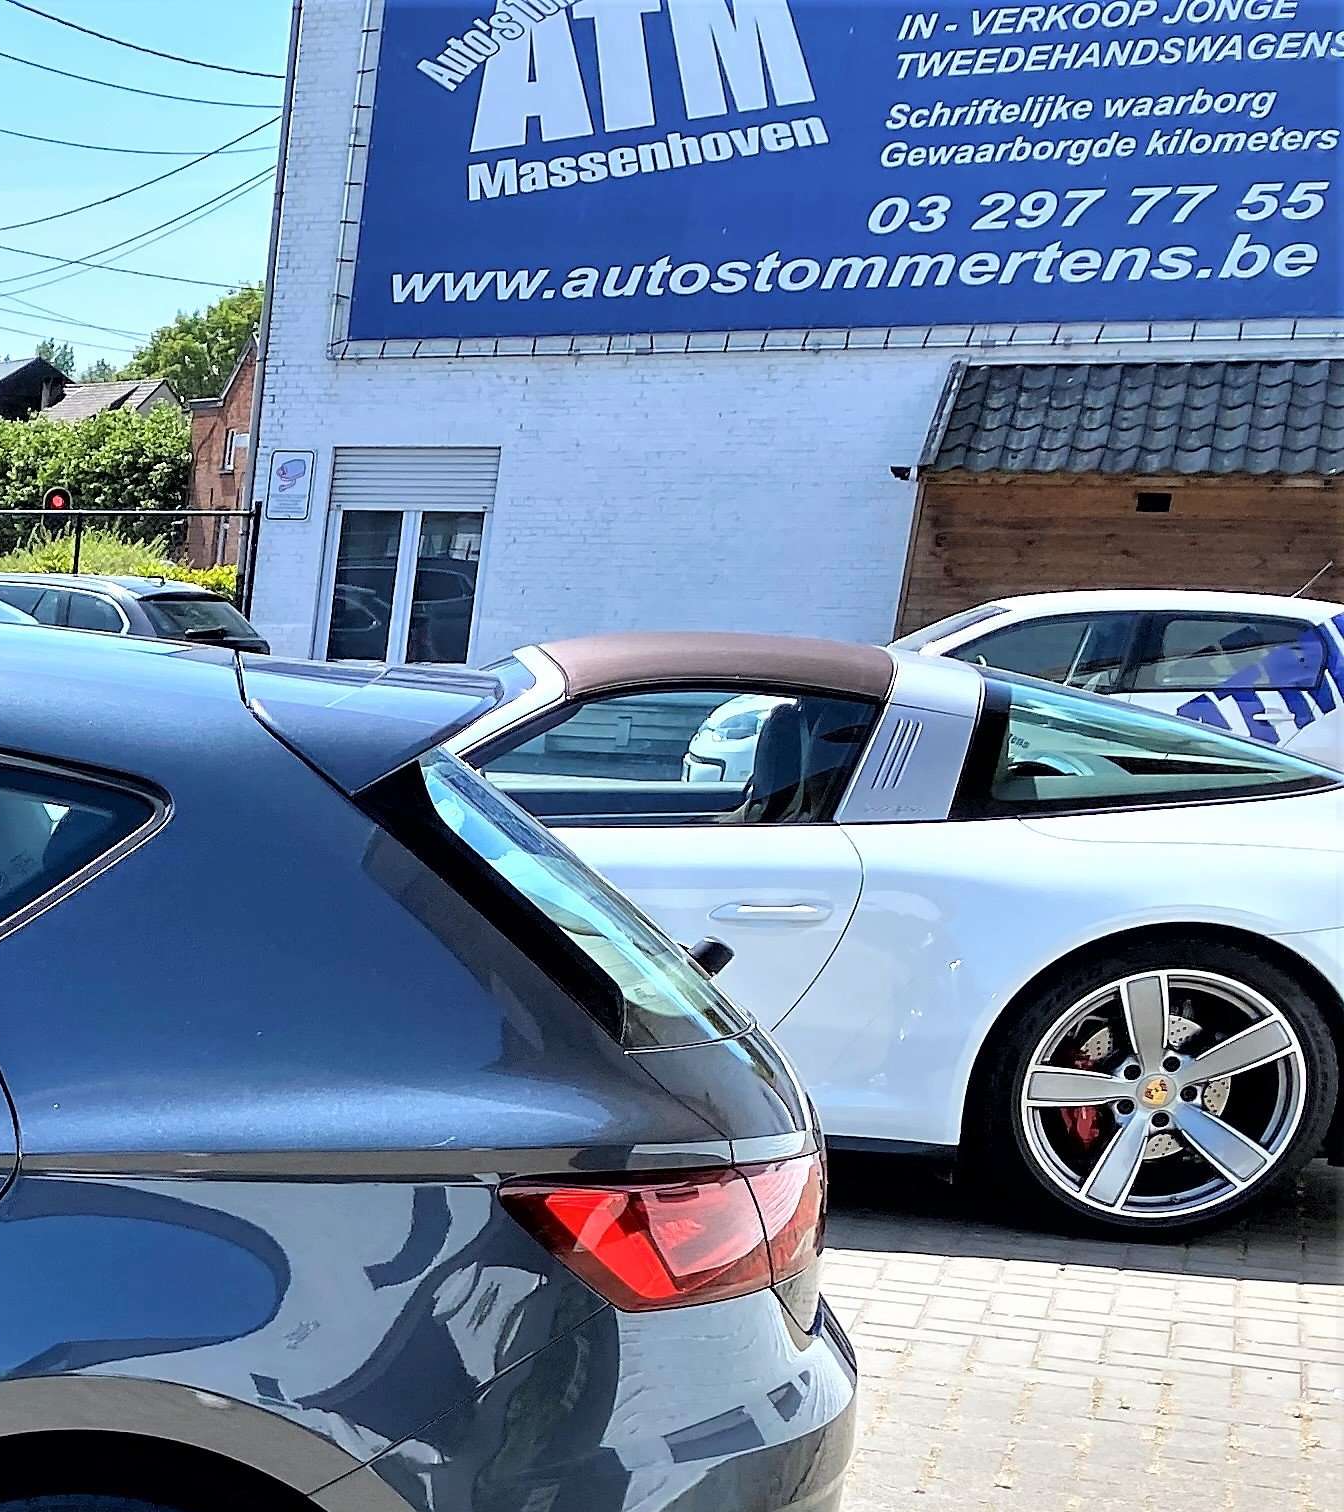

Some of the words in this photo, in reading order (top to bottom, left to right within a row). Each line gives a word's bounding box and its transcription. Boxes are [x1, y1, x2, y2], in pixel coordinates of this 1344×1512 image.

[896, 12, 938, 41] IN
[970, 0, 1158, 37] VERKOOP
[1162, 0, 1299, 26] JONGE
[416, 11, 525, 92] Auto's
[469, 0, 816, 153] ATM
[896, 31, 1344, 80] TWEEDEHANDSWAGENS
[885, 94, 1094, 130] Schriftelijke
[1103, 88, 1278, 119] waarborg
[467, 115, 830, 202] Massenhoven
[880, 130, 1137, 169] Gewaarborgde
[1144, 126, 1341, 158] kilometers
[866, 193, 953, 235] 03
[970, 187, 1106, 232] 297
[1125, 183, 1217, 227] 77
[1233, 180, 1331, 223] 55
[390, 234, 1320, 303] www.autostommertens.be
